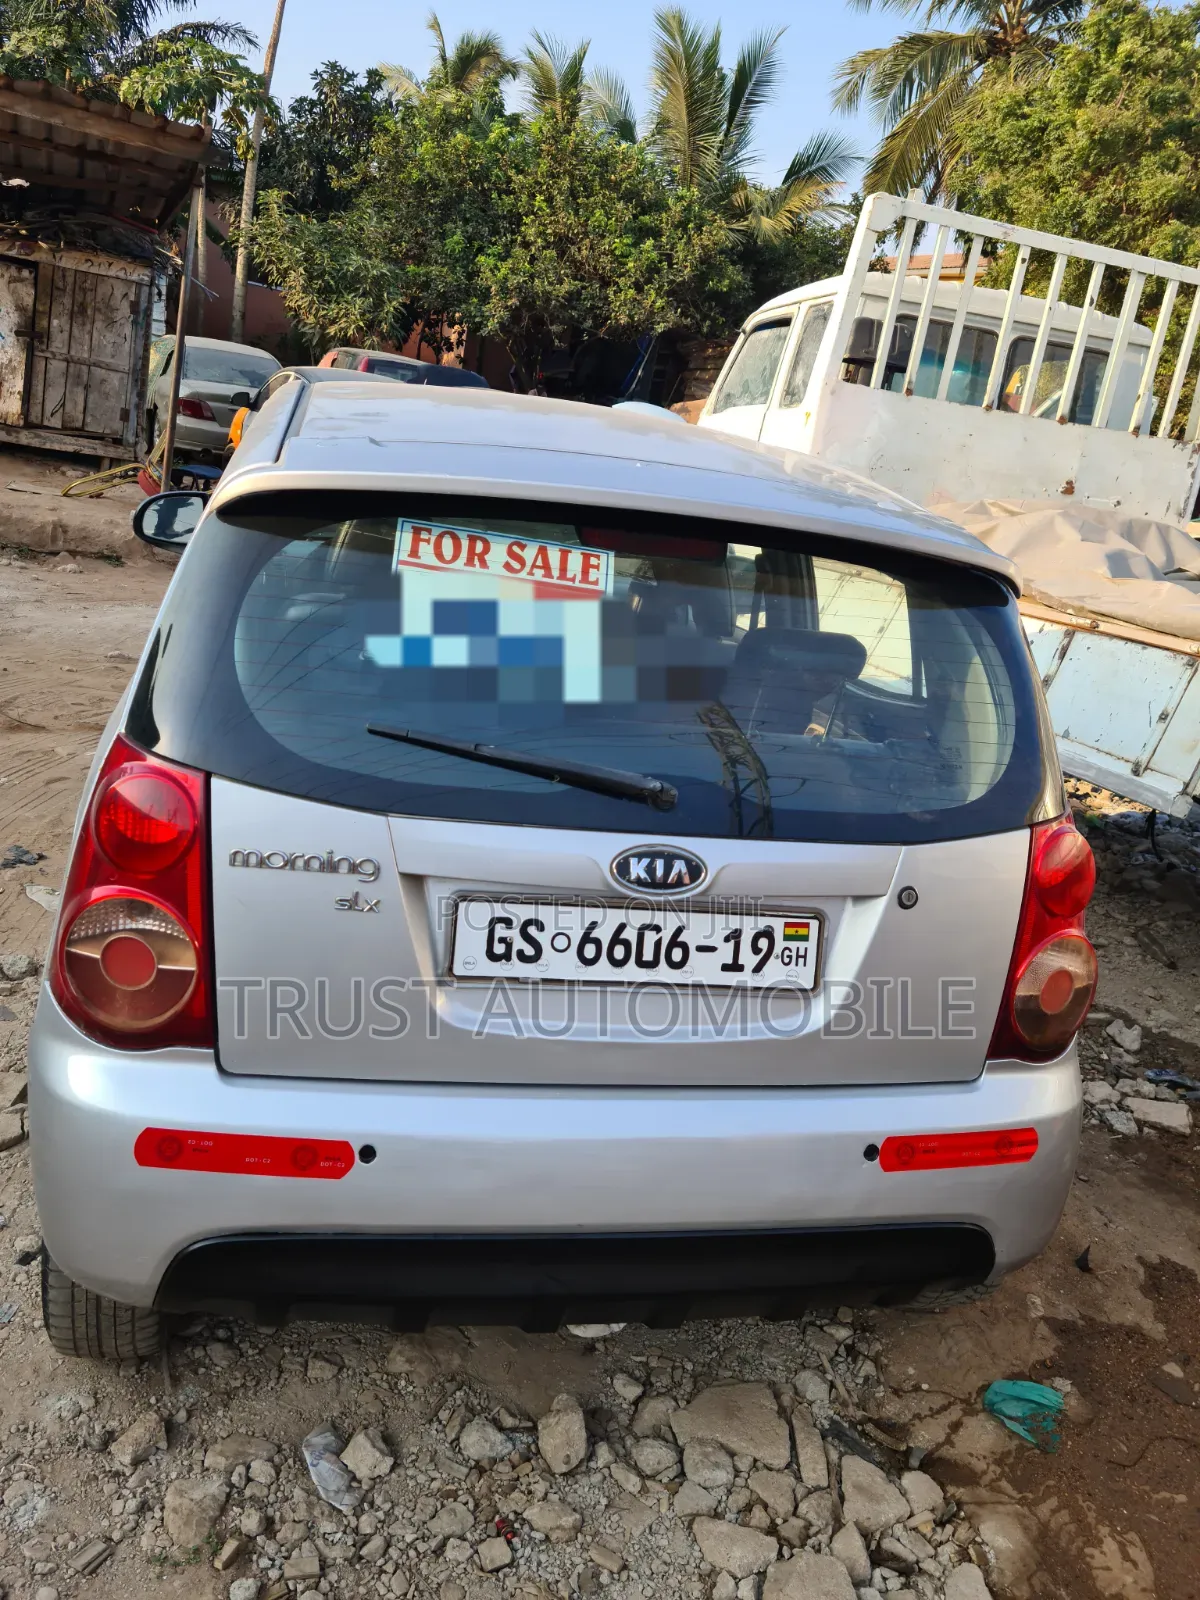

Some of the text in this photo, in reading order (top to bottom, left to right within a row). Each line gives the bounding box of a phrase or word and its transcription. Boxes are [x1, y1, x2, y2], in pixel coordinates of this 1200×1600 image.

[407, 525, 601, 586] FOR SALE
[229, 848, 381, 883] morning
[629, 857, 691, 884] KIA
[485, 916, 776, 974] GS 6606-19
[780, 946, 808, 967] GH
